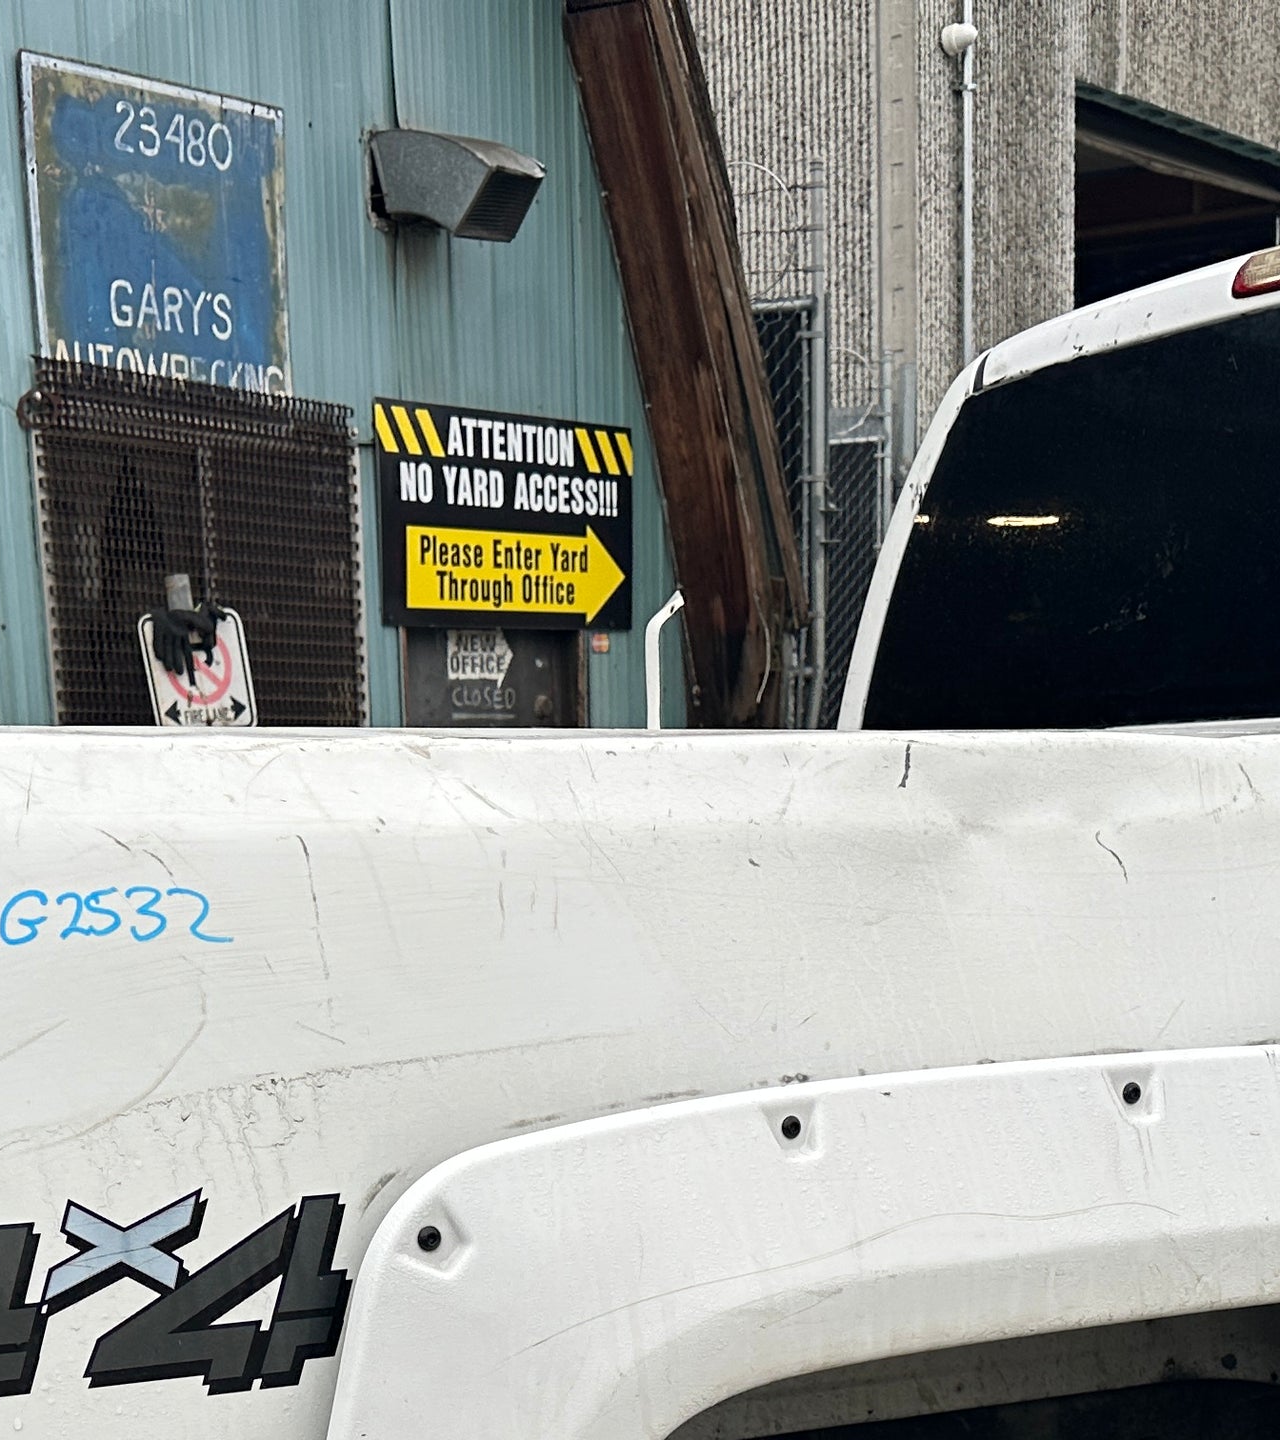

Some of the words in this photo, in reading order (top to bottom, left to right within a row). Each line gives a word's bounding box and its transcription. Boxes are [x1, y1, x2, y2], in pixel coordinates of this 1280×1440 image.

[114, 100, 233, 171] 23480
[110, 279, 233, 341] GARY'S
[447, 415, 575, 468] ATTENTION
[399, 460, 434, 504] NO
[442, 465, 505, 509] YARD
[513, 472, 619, 518] ACCESS!!!
[419, 534, 483, 569] Please
[493, 539, 542, 571] Enter
[550, 542, 589, 573] Yard
[436, 570, 514, 609] Through
[522, 574, 575, 606] Office
[455, 633, 496, 653] NEW
[450, 654, 506, 675] OFFICE
[451, 685, 517, 711] CLOSED
